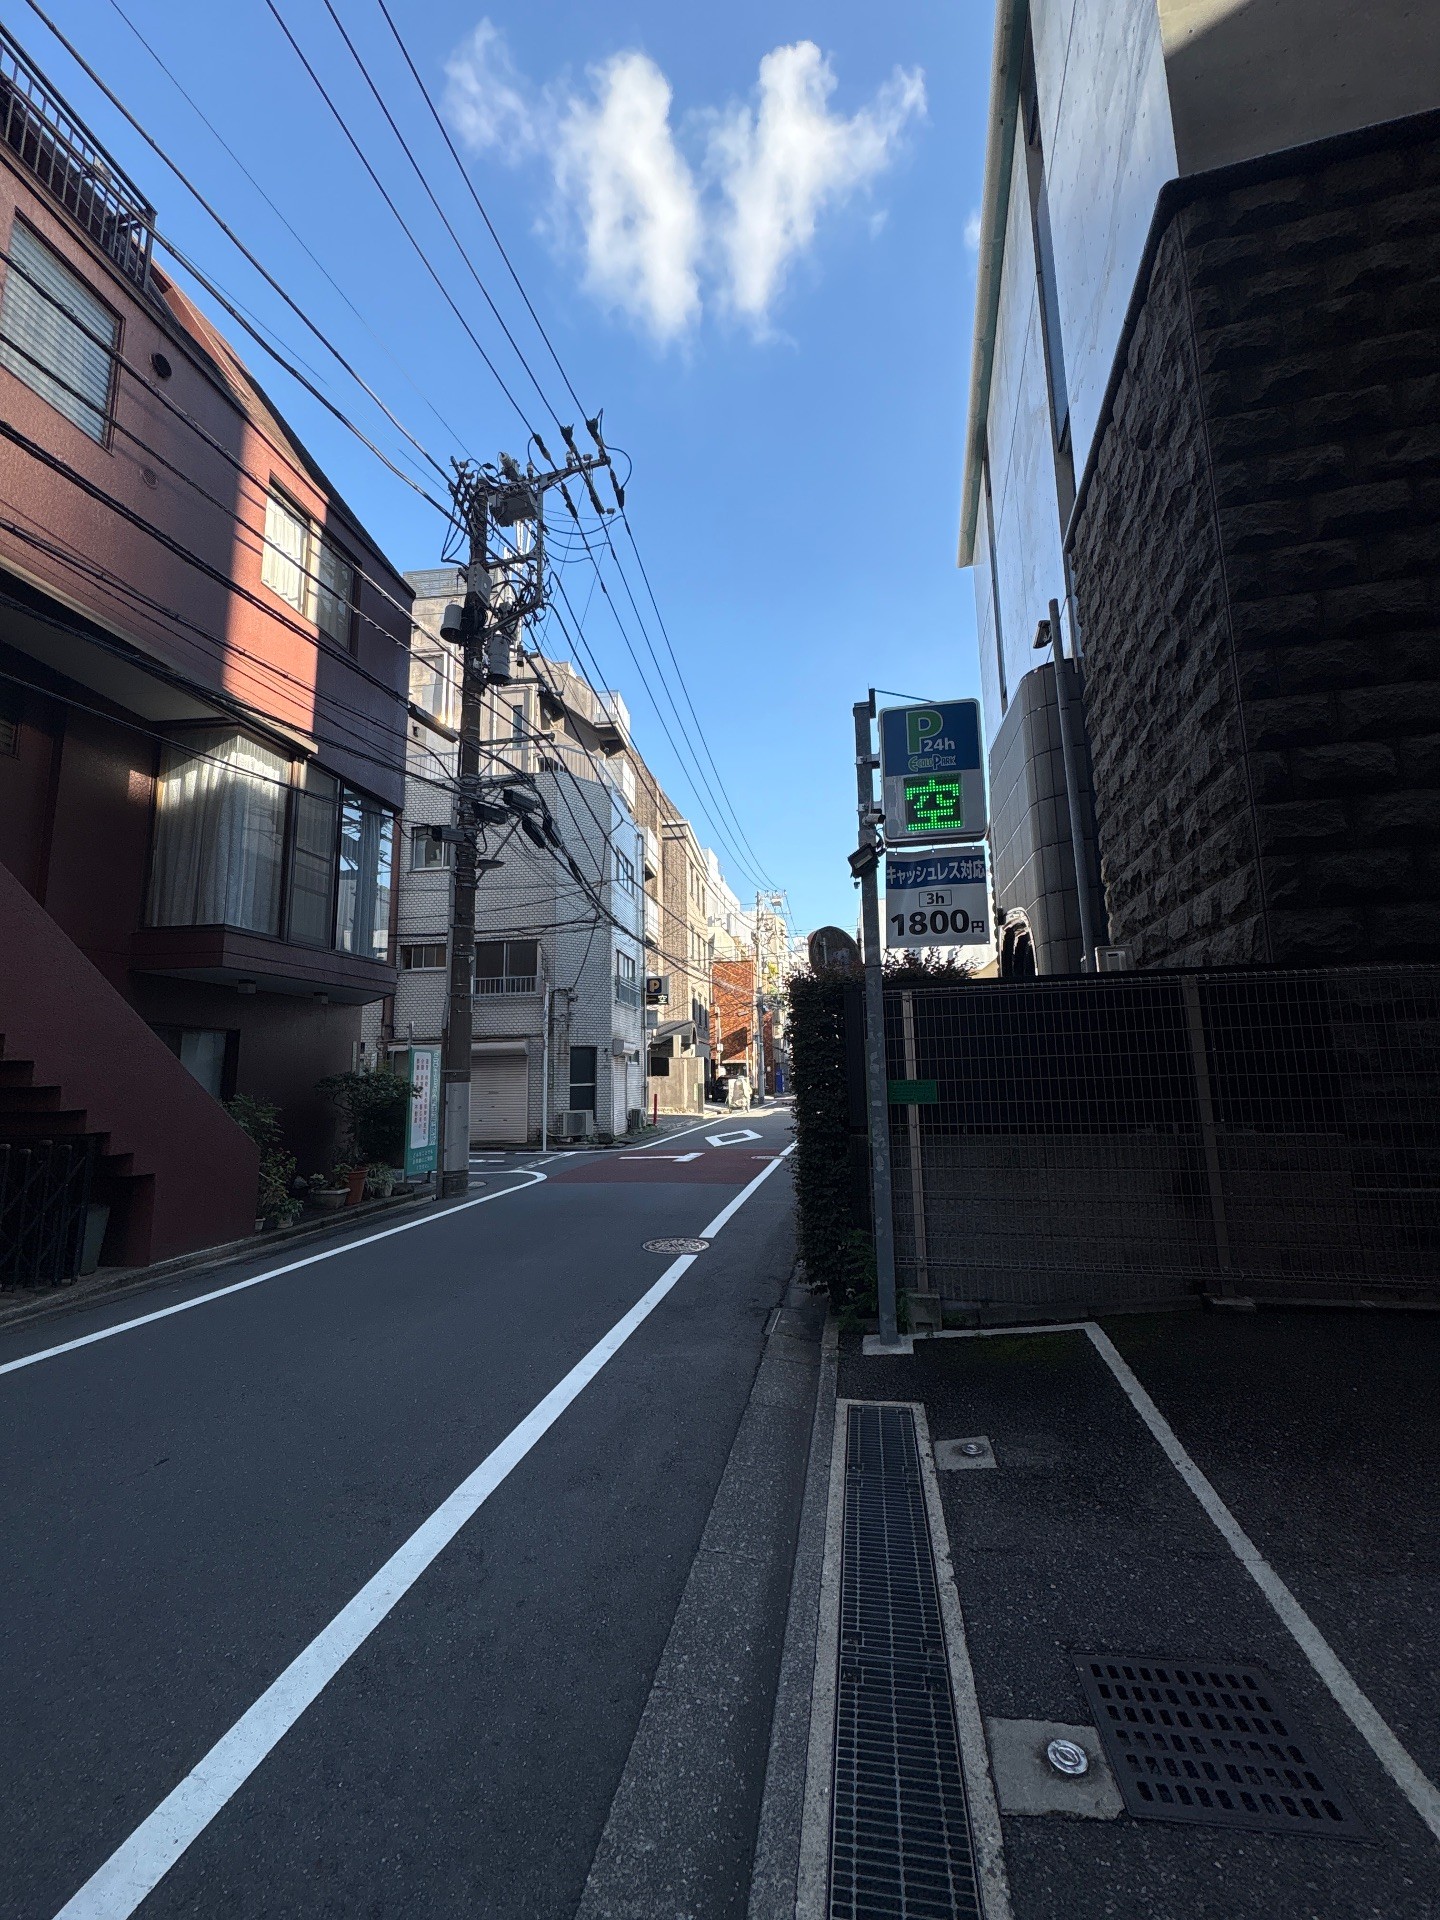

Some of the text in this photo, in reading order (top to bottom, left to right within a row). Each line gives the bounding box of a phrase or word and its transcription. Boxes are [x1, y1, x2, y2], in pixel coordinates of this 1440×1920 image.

[905, 710, 943, 754] P
[923, 738, 955, 752] 24h
[905, 780, 961, 831] 空
[886, 860, 985, 885] キャッシュレス対応
[926, 893, 945, 905] 3h
[891, 909, 985, 937] 1800円
[658, 995, 667, 1003] 空
